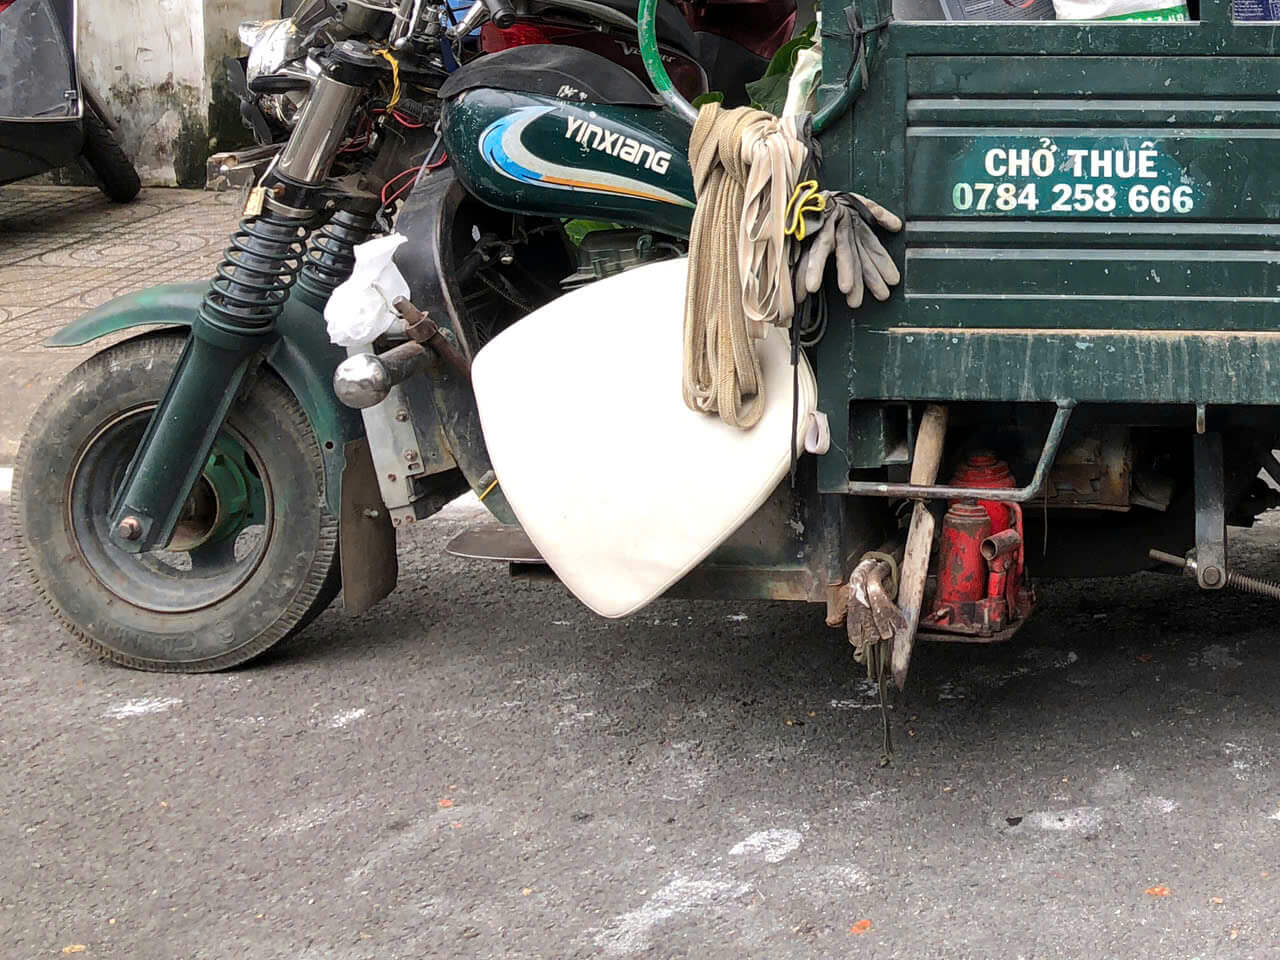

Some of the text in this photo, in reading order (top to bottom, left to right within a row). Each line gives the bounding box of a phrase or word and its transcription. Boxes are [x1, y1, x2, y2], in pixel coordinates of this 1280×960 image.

[984, 137, 1158, 178] CHỞ THUÊ
[952, 182, 1194, 214] 0784 258 666
